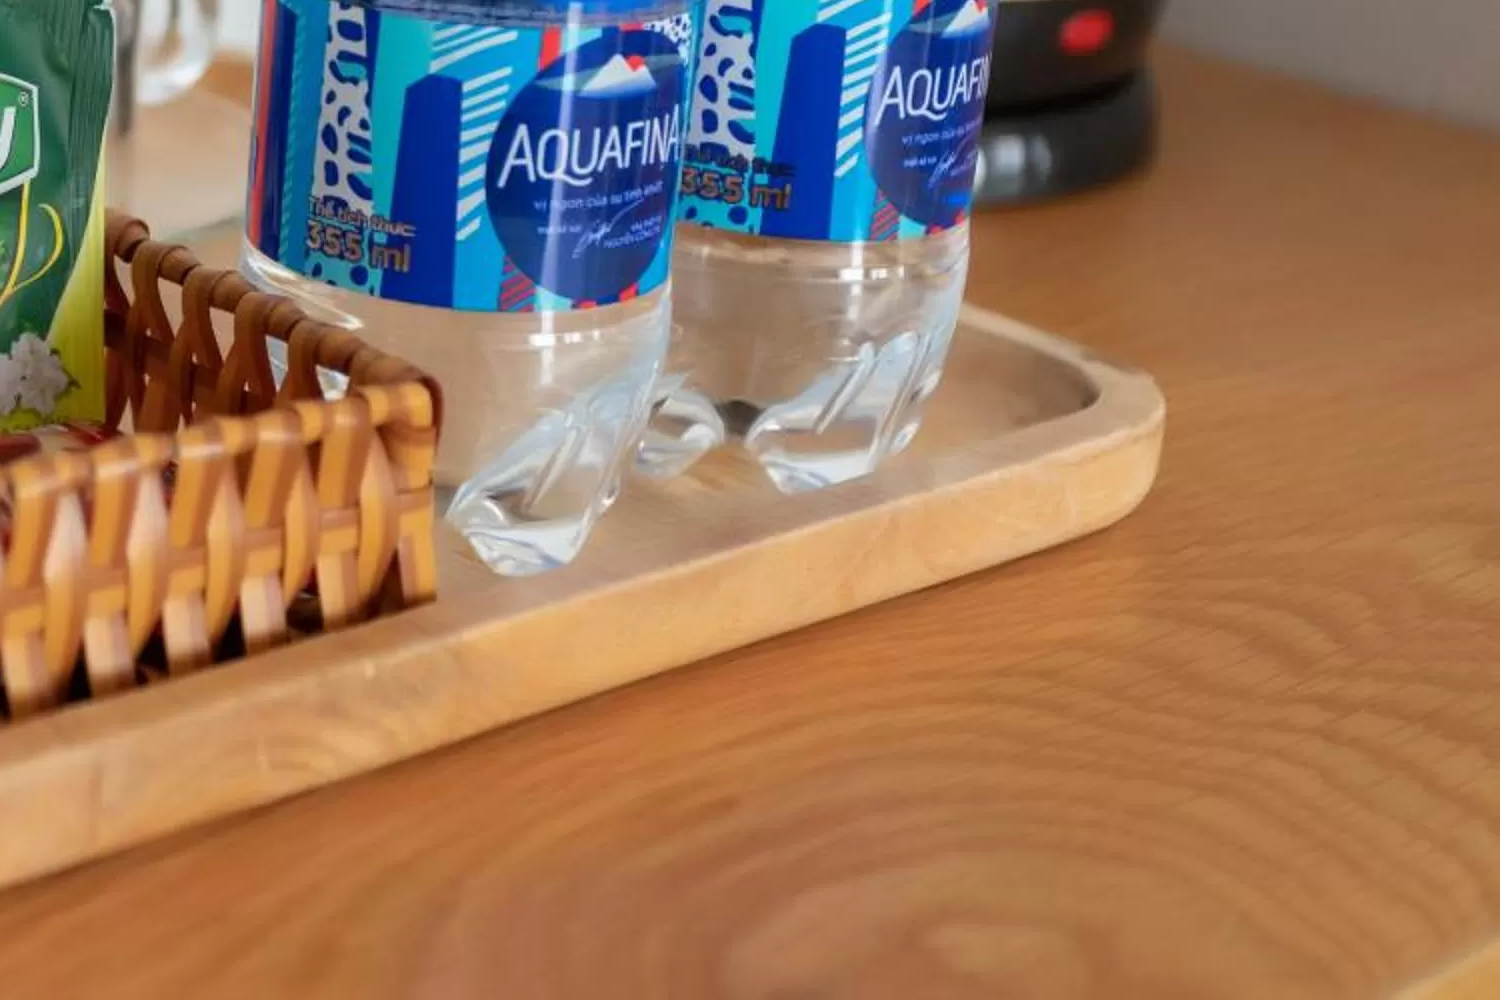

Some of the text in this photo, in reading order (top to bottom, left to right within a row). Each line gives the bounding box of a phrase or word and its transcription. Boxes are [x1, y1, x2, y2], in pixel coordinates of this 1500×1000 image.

[873, 50, 992, 127] AQUAFIN
[496, 103, 680, 188] AQUAFINA
[681, 167, 792, 210] 355 ml
[305, 219, 412, 274] 355 ml
